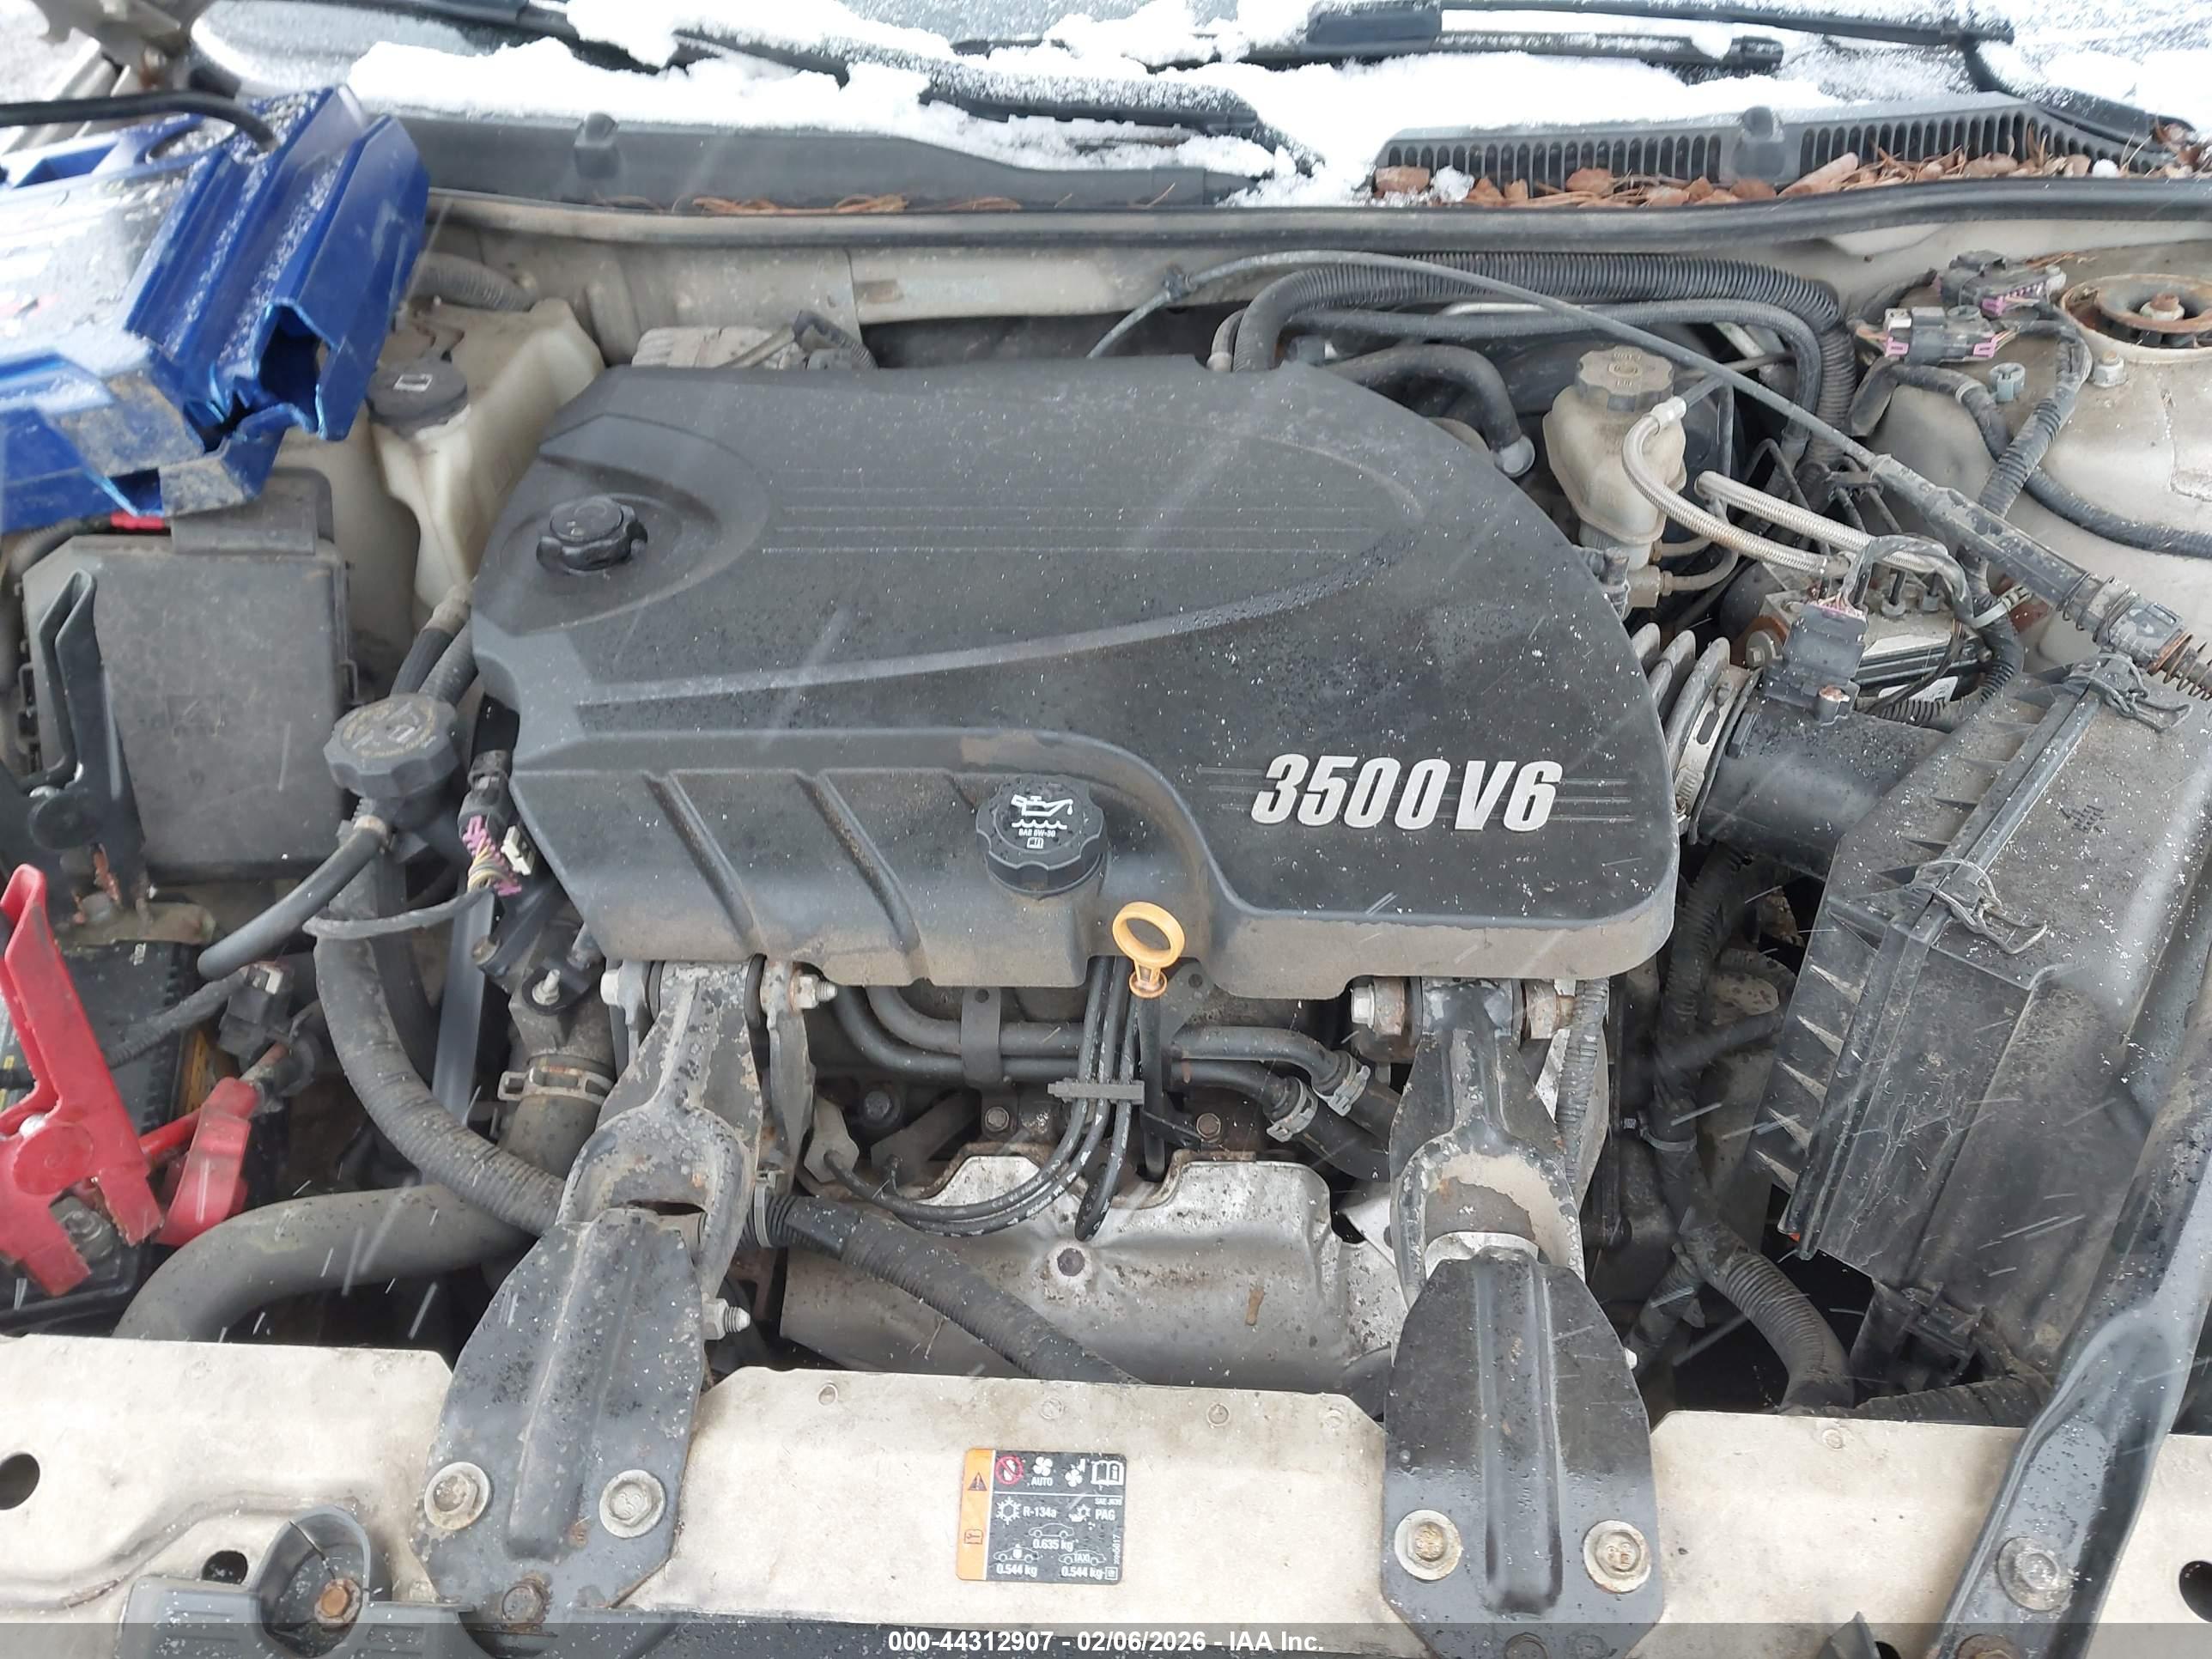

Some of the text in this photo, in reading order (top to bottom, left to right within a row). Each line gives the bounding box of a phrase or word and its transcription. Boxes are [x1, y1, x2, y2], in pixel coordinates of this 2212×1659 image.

[1251, 754, 1563, 832] 3500 V6
[1031, 1477, 1053, 1486] AUTO
[1023, 1506, 1057, 1518] R-134a
[1095, 1509, 1115, 1521] PAG
[1032, 1539, 1073, 1553] 0.635 kg
[1073, 1553, 1090, 1562] TAXI
[996, 1564, 1037, 1577] 0.544 kg
[1061, 1566, 1103, 1580] 0.544 kg
